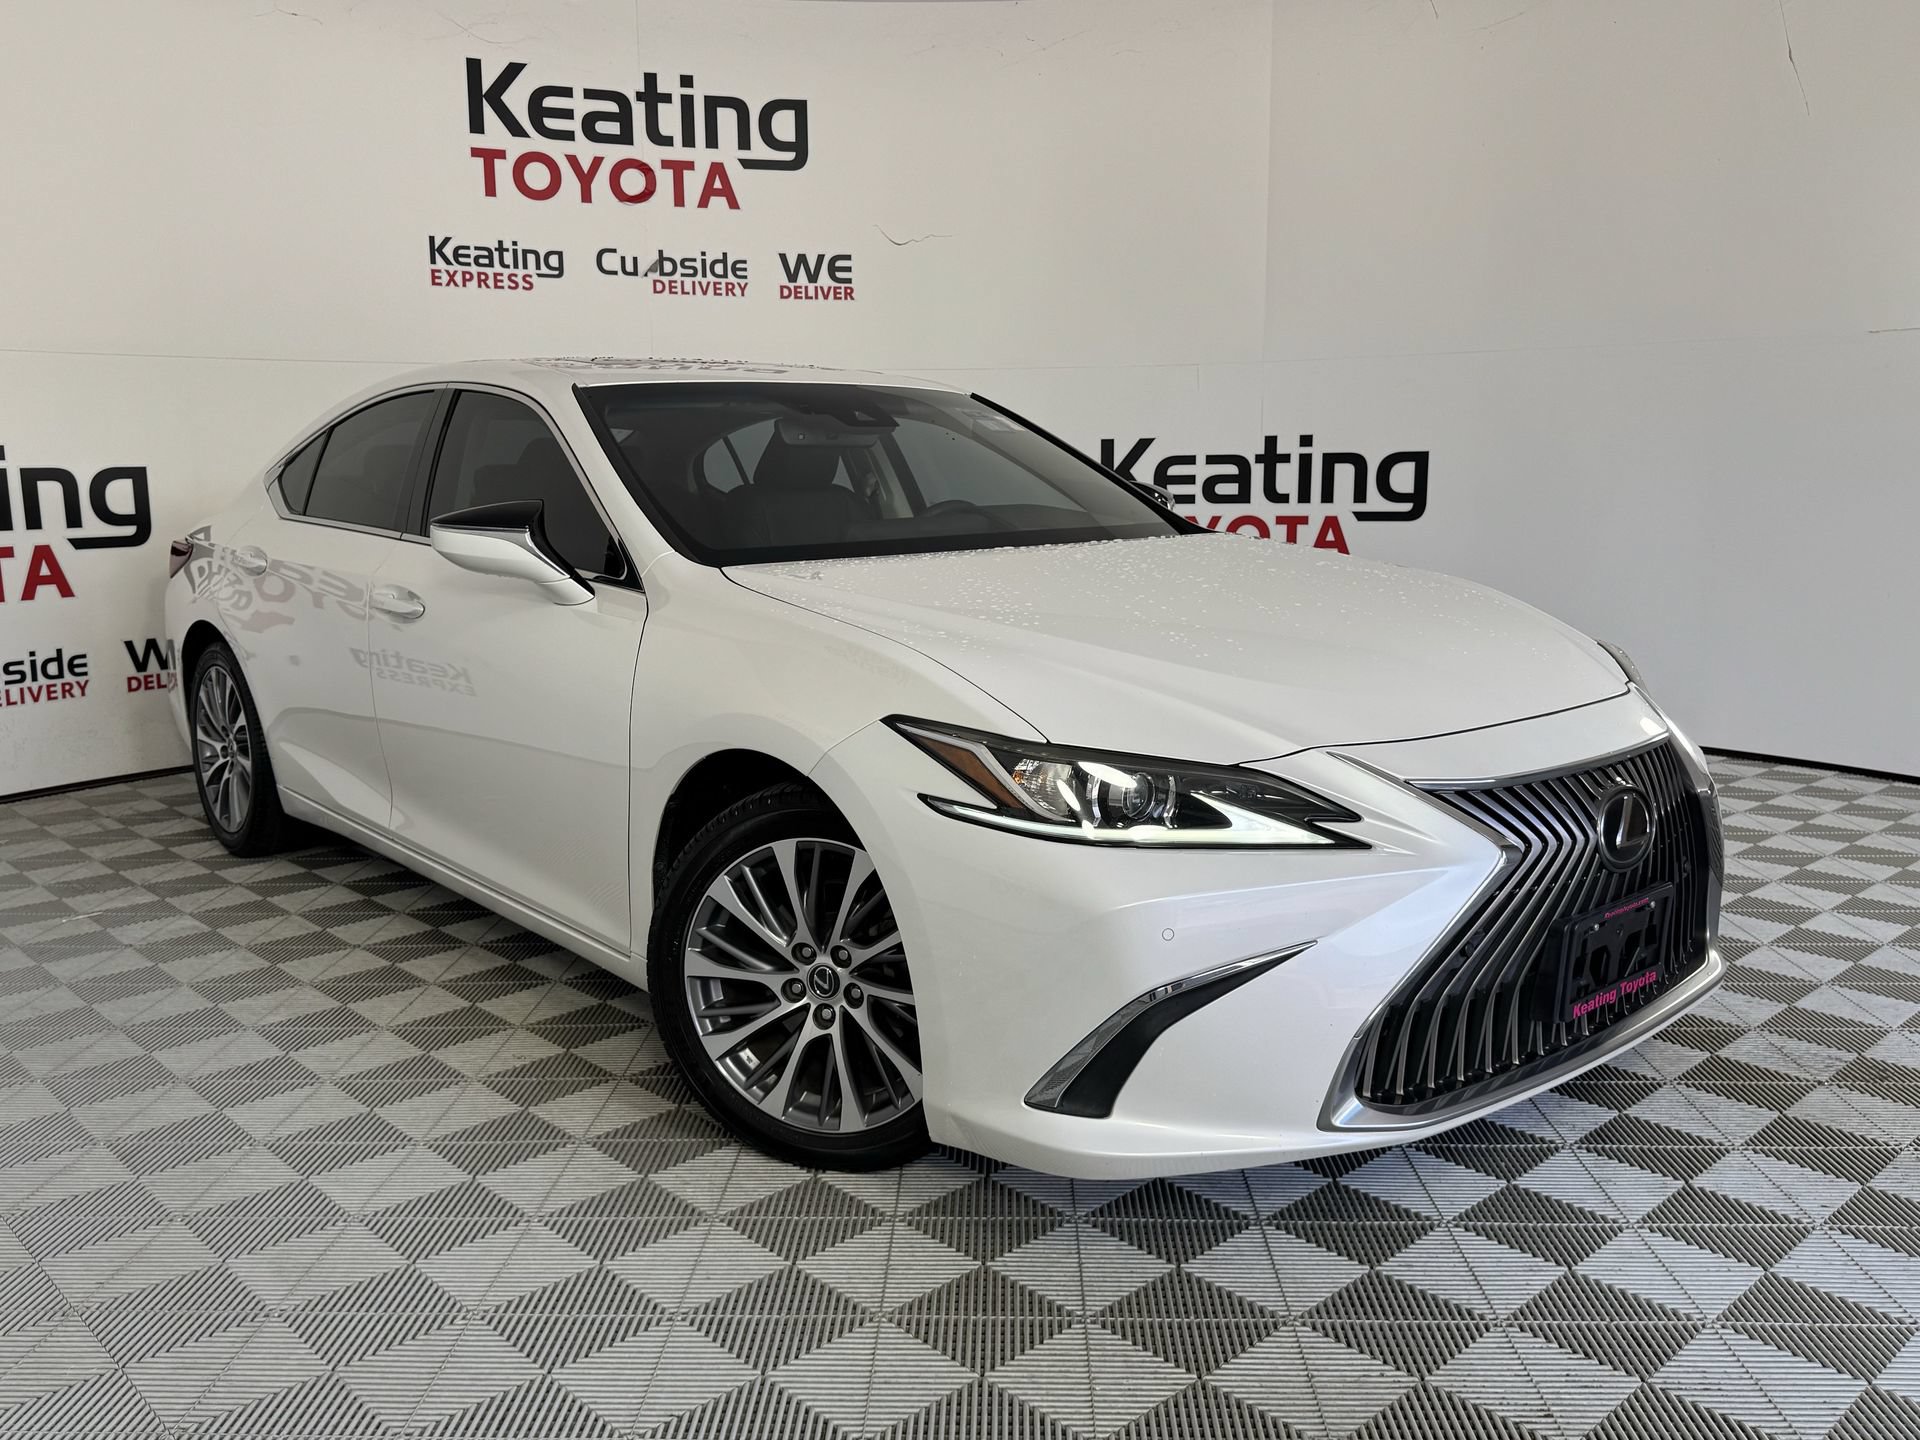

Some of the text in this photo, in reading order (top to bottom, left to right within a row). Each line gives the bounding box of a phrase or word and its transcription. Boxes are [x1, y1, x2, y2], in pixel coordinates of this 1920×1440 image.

[466, 57, 809, 171] Keating
[470, 146, 741, 210] TOYOTA
[428, 235, 564, 279] Keating
[595, 247, 748, 280] Cubside
[778, 253, 853, 285] WE
[430, 269, 535, 291] EXPRESS
[652, 279, 749, 297] DELIVERY
[779, 284, 855, 301] DELIVER
[1100, 433, 1430, 522] Keating
[0, 679, 90, 707] LIVERY
[1572, 971, 1657, 1020] Keating Toyota
